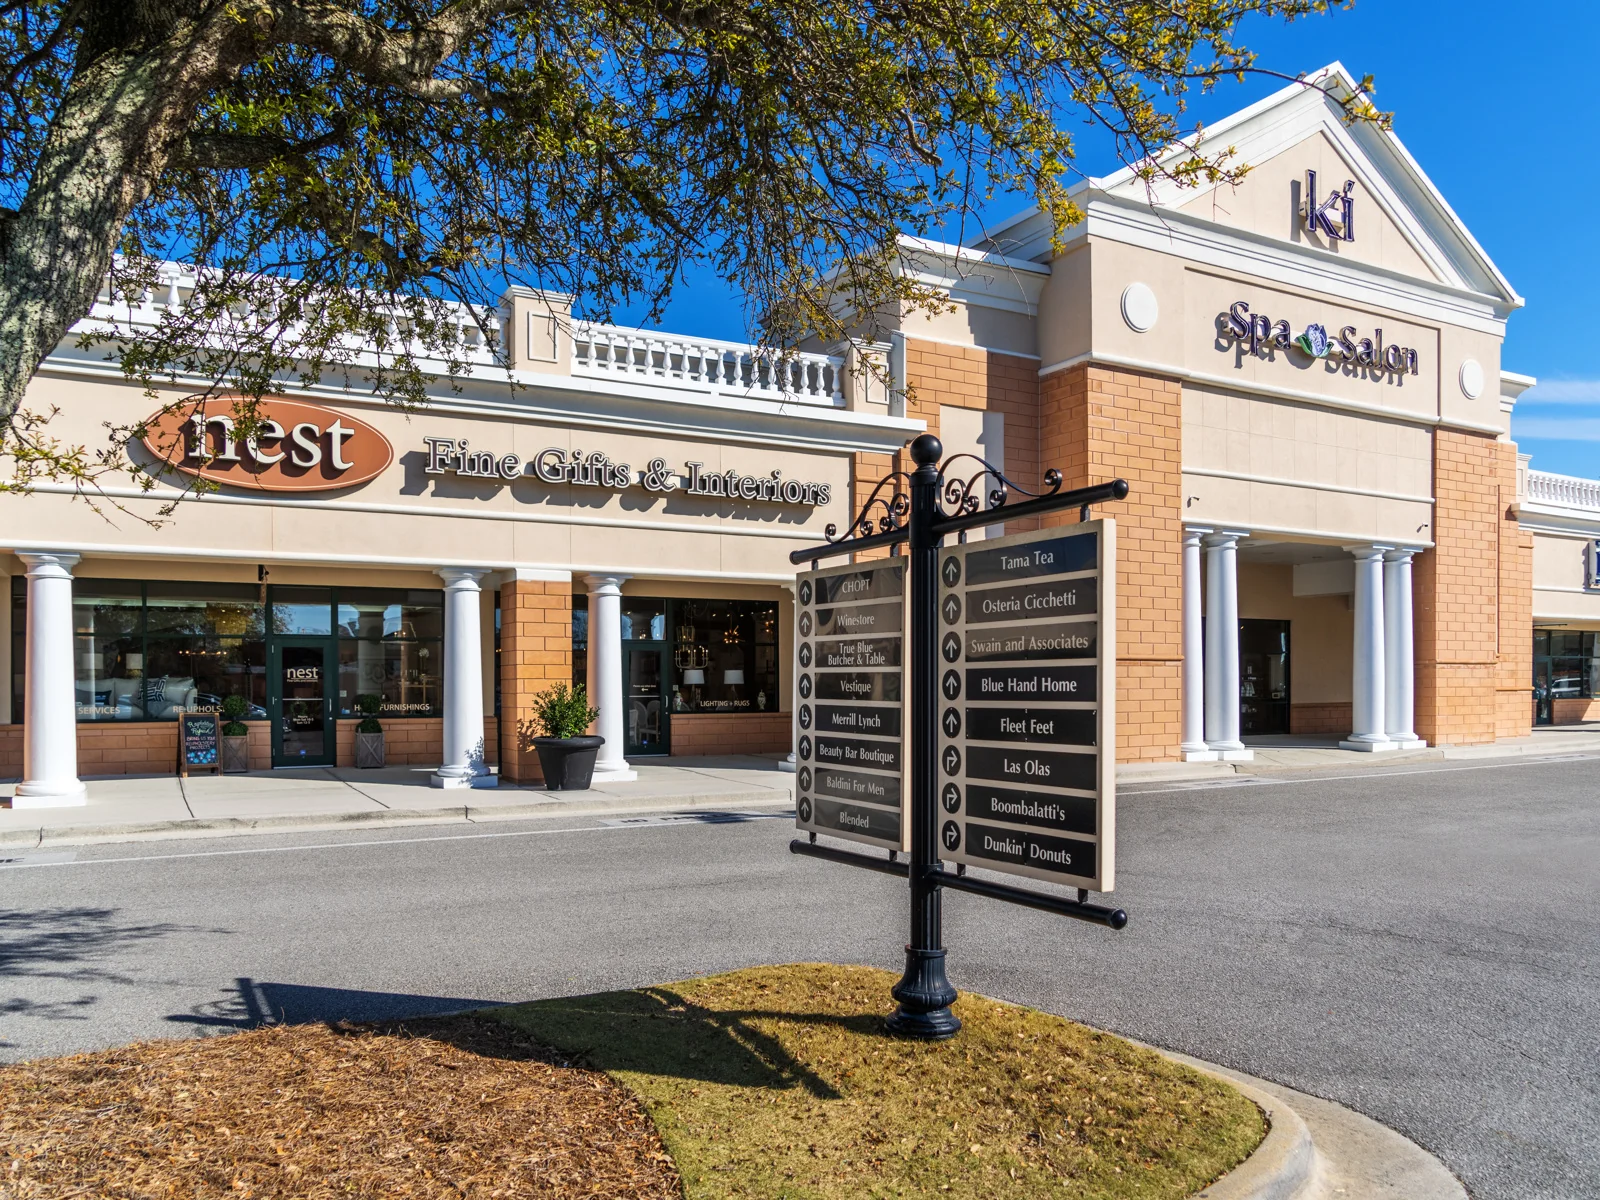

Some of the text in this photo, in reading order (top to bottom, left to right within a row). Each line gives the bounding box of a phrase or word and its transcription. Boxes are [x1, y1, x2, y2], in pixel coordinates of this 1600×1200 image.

[1305, 169, 1355, 243] ki
[1228, 301, 1419, 376] Spa Salon
[189, 413, 355, 470] nest
[424, 436, 832, 506] Fine Gifts & Interiors
[1001, 550, 1054, 570] Tama Tea
[842, 578, 871, 593] CHOPT
[982, 589, 1076, 613] Osteria Cicchetti
[837, 614, 875, 627] Winestore
[839, 640, 874, 654] True Blue
[971, 633, 1089, 653] Swain and Associates
[828, 652, 885, 666] Butcher & Table
[287, 667, 318, 678] nest
[840, 680, 871, 695] Vestique
[981, 676, 1077, 692] Blue Hand Home
[78, 706, 121, 715] SERVICES
[379, 703, 430, 711] FURNISHINGS
[831, 713, 881, 729] Merrill Lynch
[1000, 717, 1054, 735] Fleet Feet
[819, 743, 894, 765] Beauty Bar Boutique
[1004, 758, 1050, 776] Las Olas
[826, 776, 885, 796] Baldini For Men
[991, 797, 1066, 821] Boombalatti's
[839, 811, 869, 828] Blended
[984, 835, 1072, 865] Dunkin' Donuts
